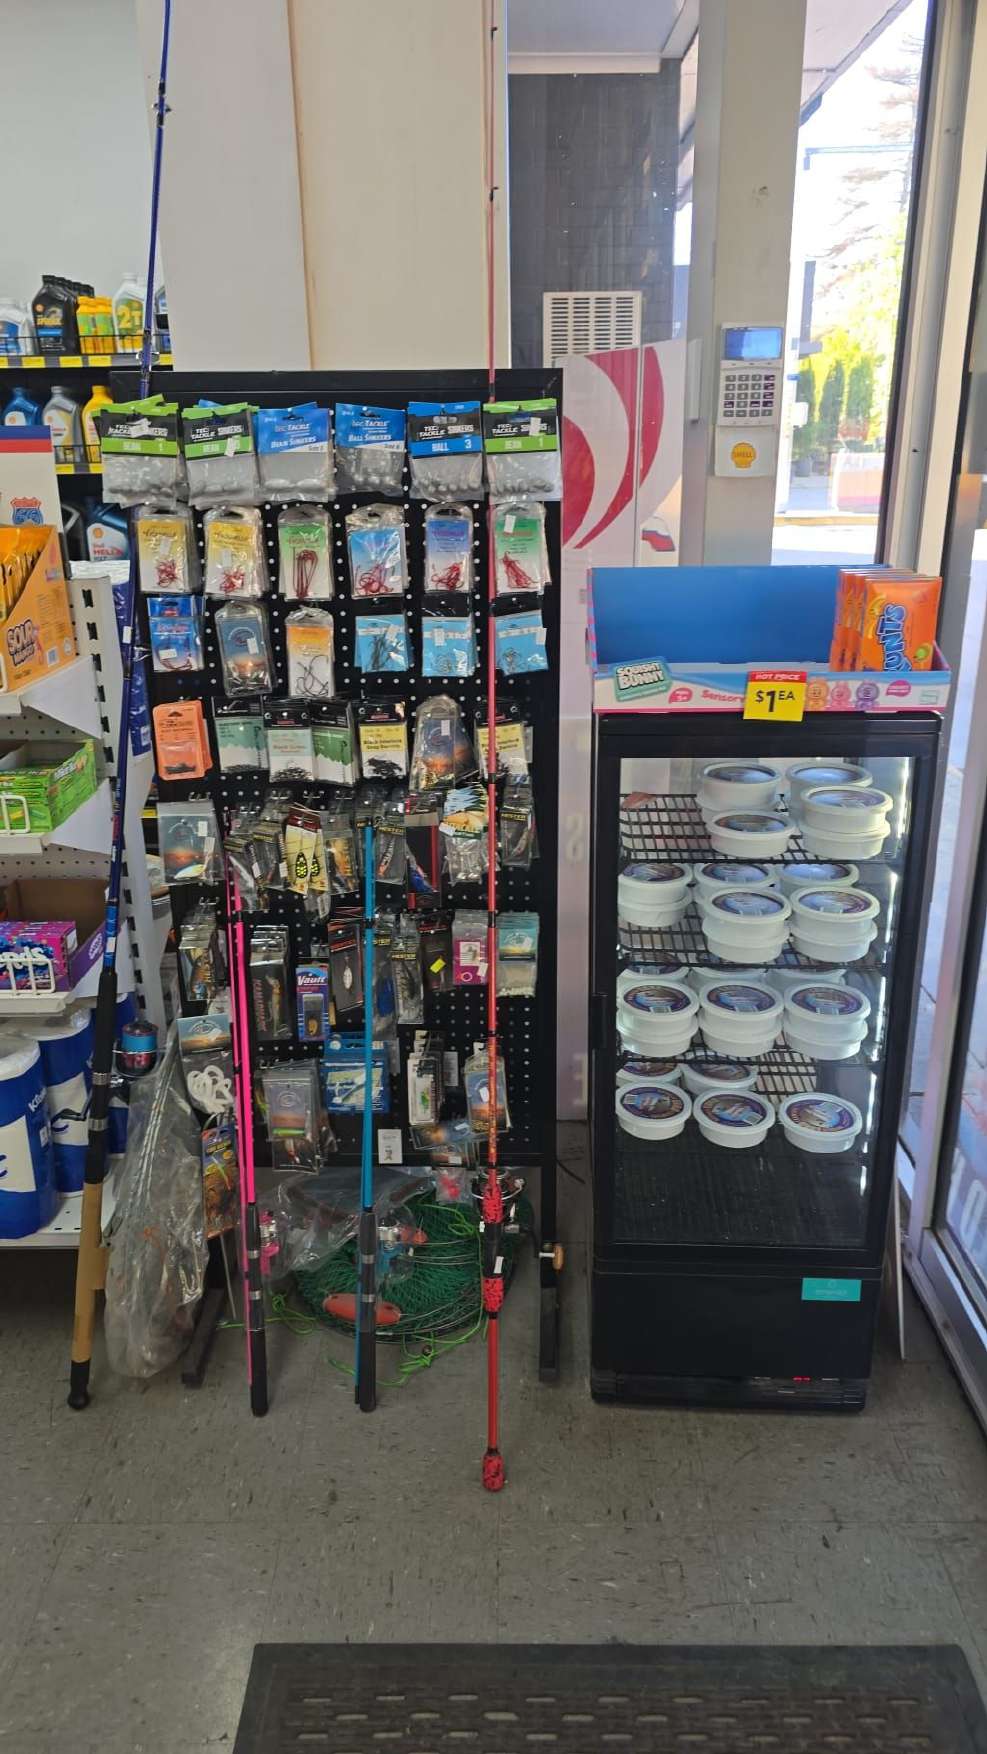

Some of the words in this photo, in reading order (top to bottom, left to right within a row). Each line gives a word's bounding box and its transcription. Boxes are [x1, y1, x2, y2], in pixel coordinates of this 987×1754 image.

[419, 430, 447, 438] TACKLE
[464, 438, 472, 449] 3
[618, 670, 664, 690] BUNNY
[755, 672, 773, 681] HOT
[774, 673, 801, 681] PRICE
